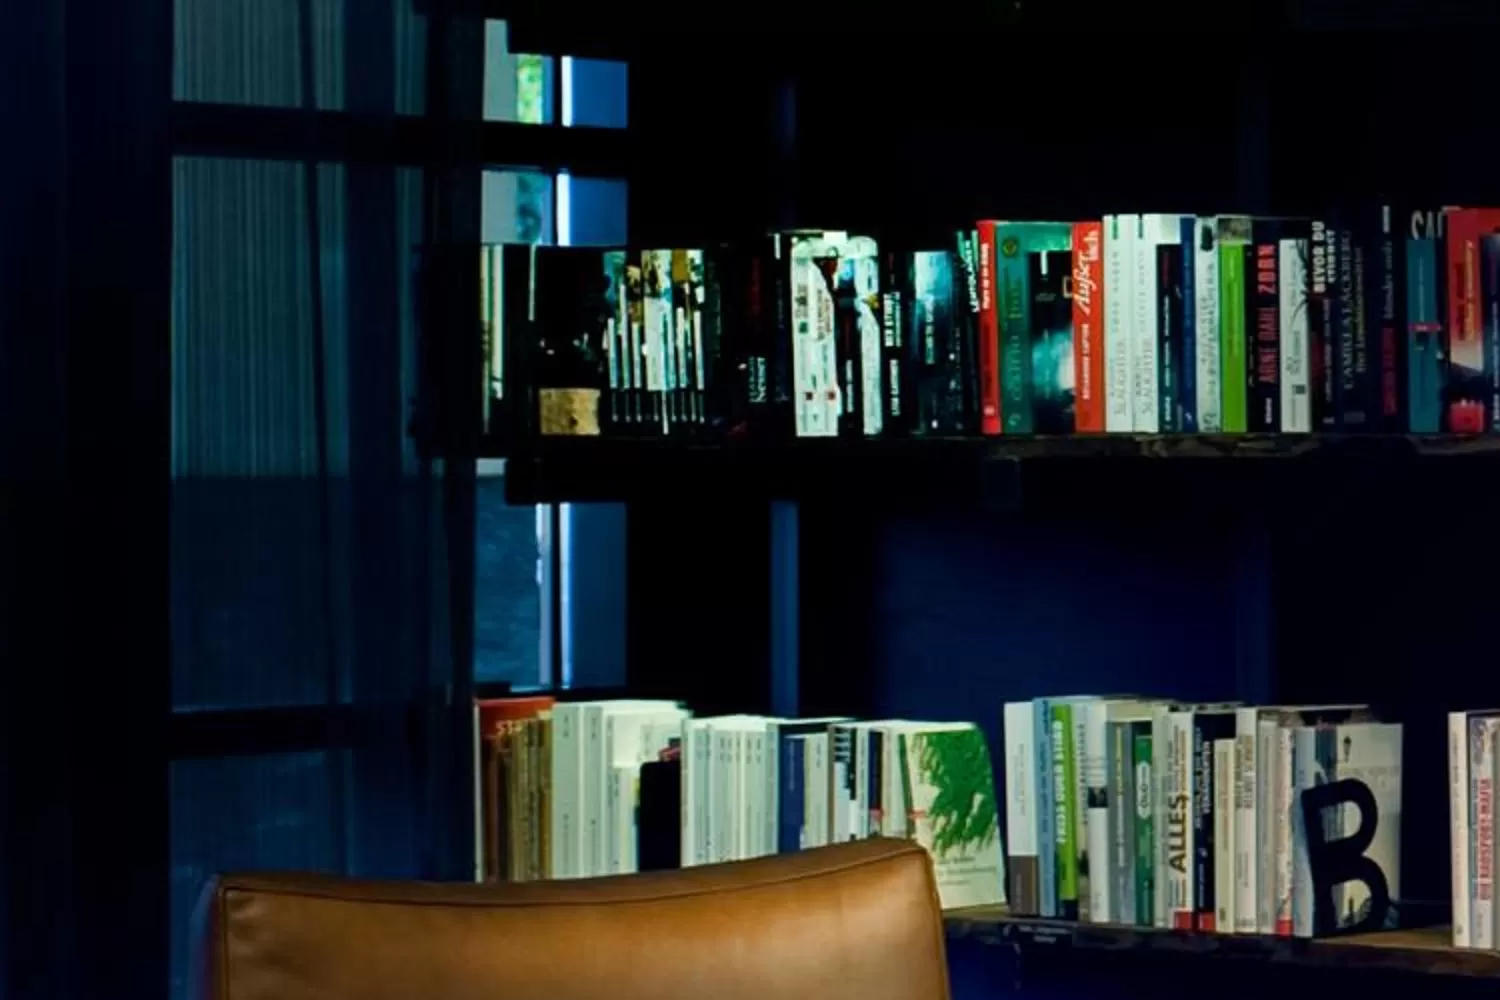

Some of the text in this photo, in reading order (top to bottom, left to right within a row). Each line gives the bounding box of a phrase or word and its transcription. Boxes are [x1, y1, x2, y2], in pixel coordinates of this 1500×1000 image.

[1256, 243, 1276, 294] ZORN
[1312, 220, 1326, 293] BEVOR DU
[1300, 778, 1390, 936] B
